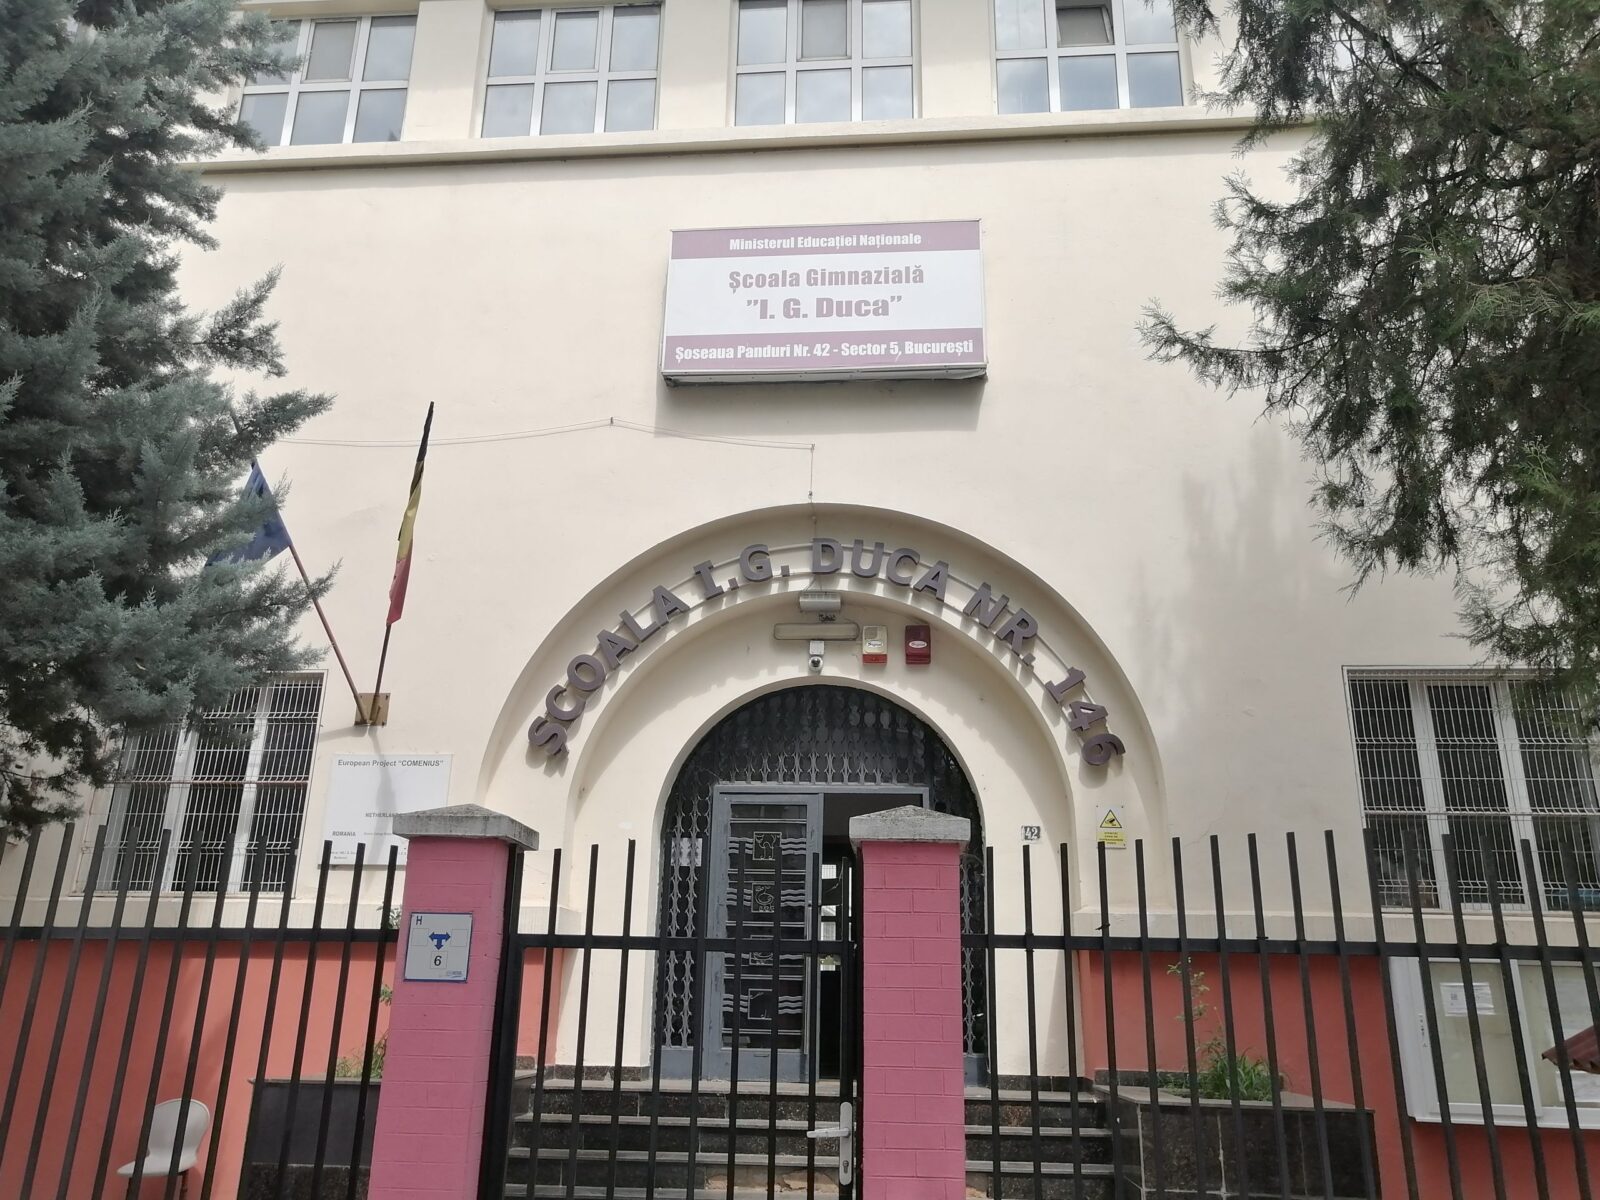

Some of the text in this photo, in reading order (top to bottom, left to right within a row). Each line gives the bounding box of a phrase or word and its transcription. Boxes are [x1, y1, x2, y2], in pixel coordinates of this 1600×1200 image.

[729, 233, 923, 251] Ministerul Educației Naționale
[728, 265, 925, 294] Școala Gimnazială
[782, 297, 809, 319] G.
[675, 346, 735, 364] Șoseaua
[737, 344, 791, 359] Panduri
[793, 343, 811, 357] Nr.
[813, 342, 831, 357] 42
[841, 342, 888, 357] Sector
[904, 339, 975, 357] București
[811, 537, 949, 602] DUCA
[962, 581, 1037, 667] NR.
[1045, 666, 1126, 766] 146
[337, 759, 371, 767] European
[372, 759, 397, 768] Project
[1025, 827, 1039, 839] 42
[415, 915, 423, 926] H
[433, 955, 442, 967] 6
